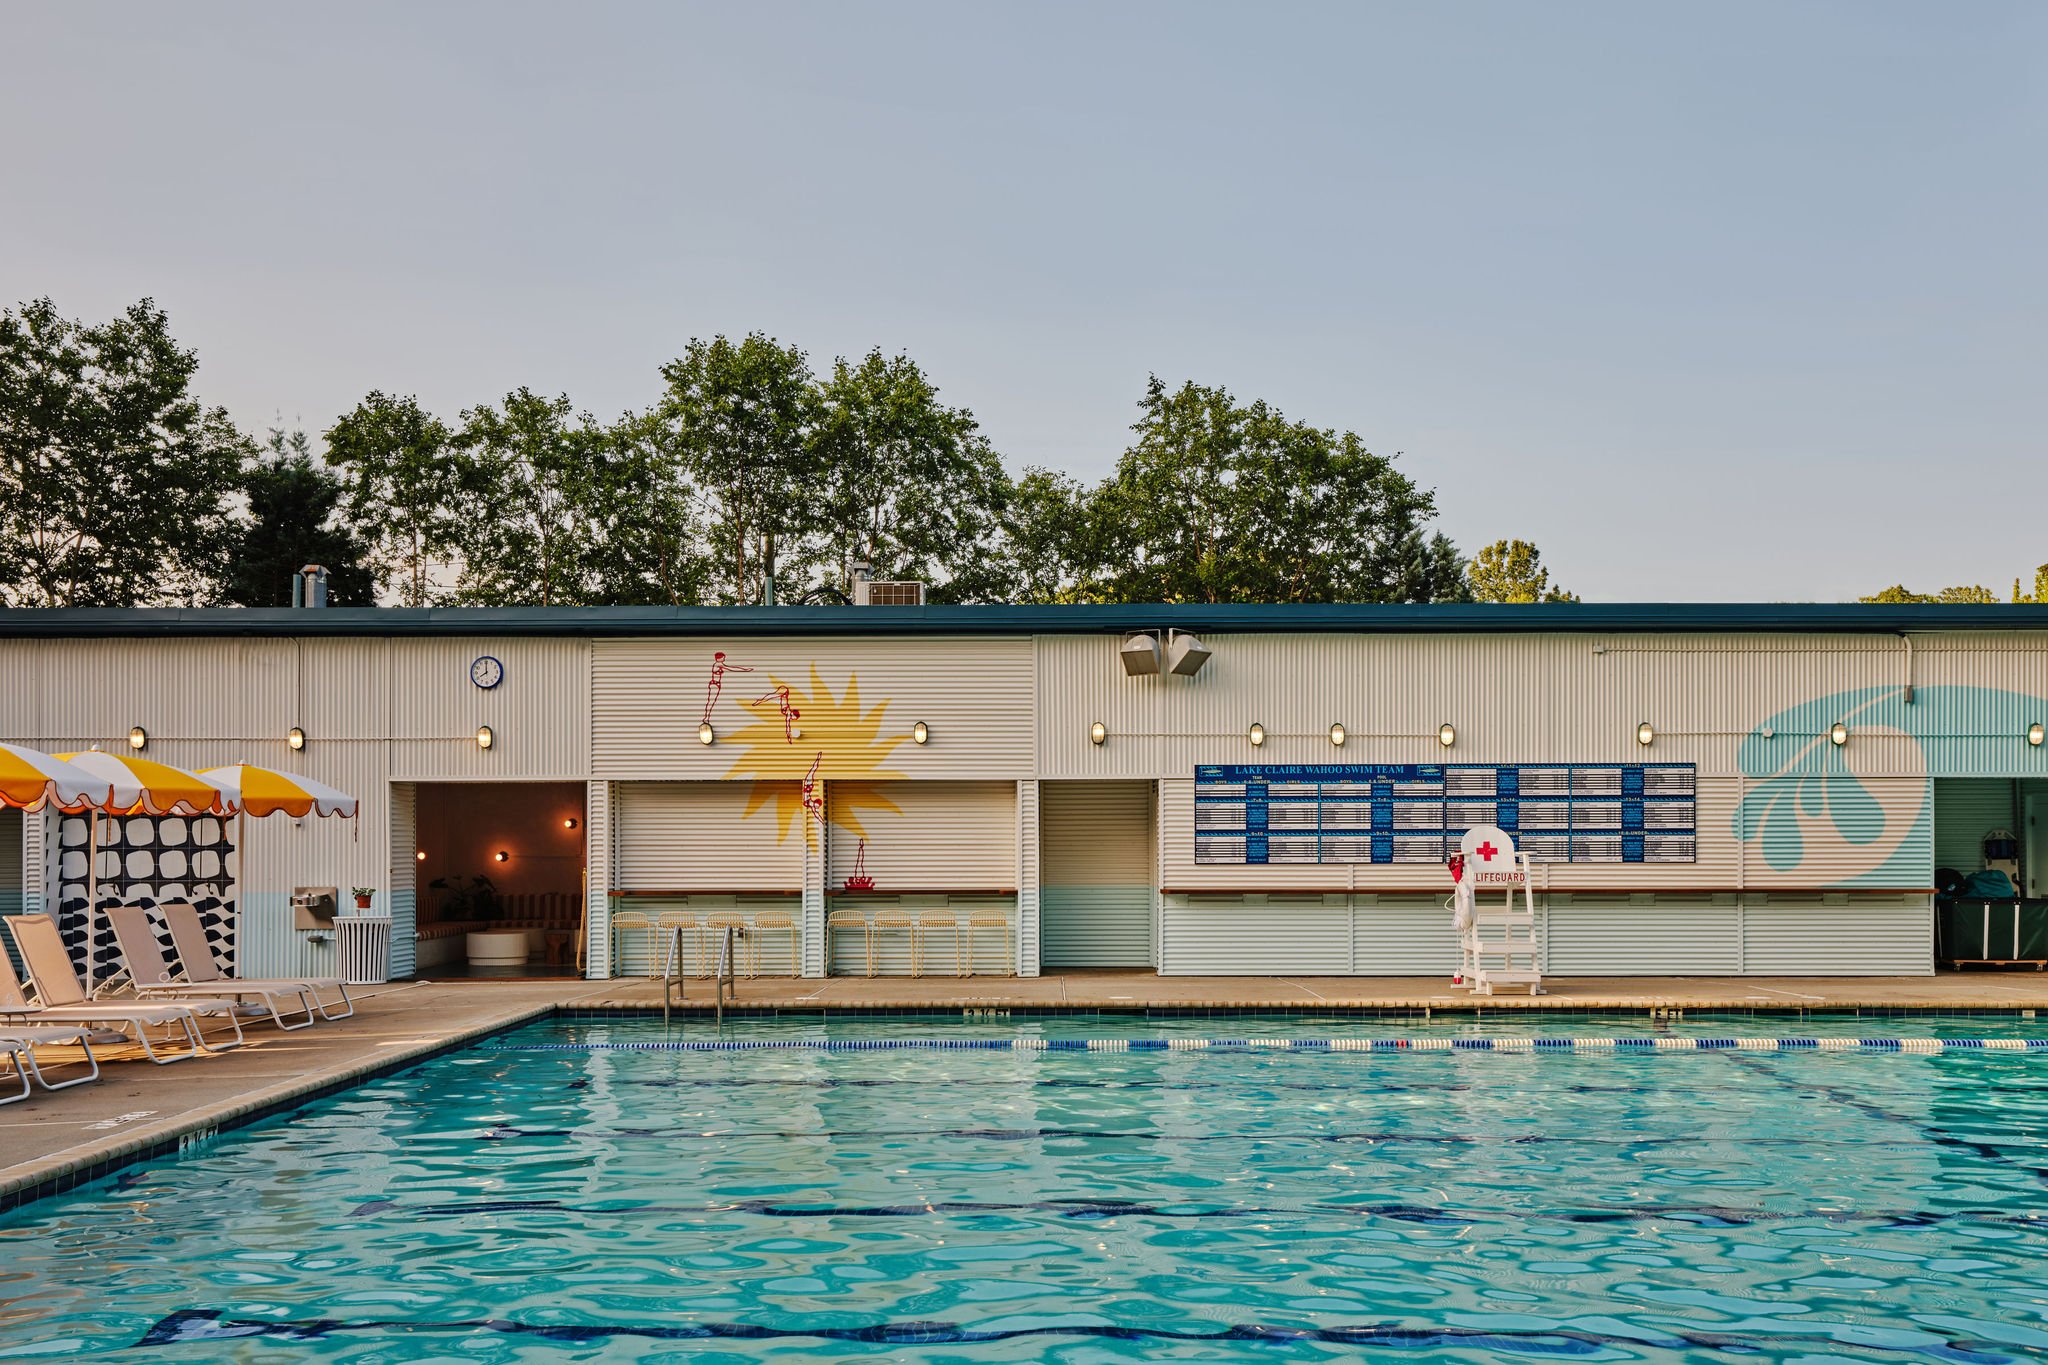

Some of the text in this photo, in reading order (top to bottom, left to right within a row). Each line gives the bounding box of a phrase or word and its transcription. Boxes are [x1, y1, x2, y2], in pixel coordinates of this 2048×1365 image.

[1235, 766, 1262, 774] LAKE
[1265, 766, 1302, 774] CLAIRE
[1306, 766, 1342, 774] WAHOO
[1476, 873, 1525, 882] LIFEGUARD
